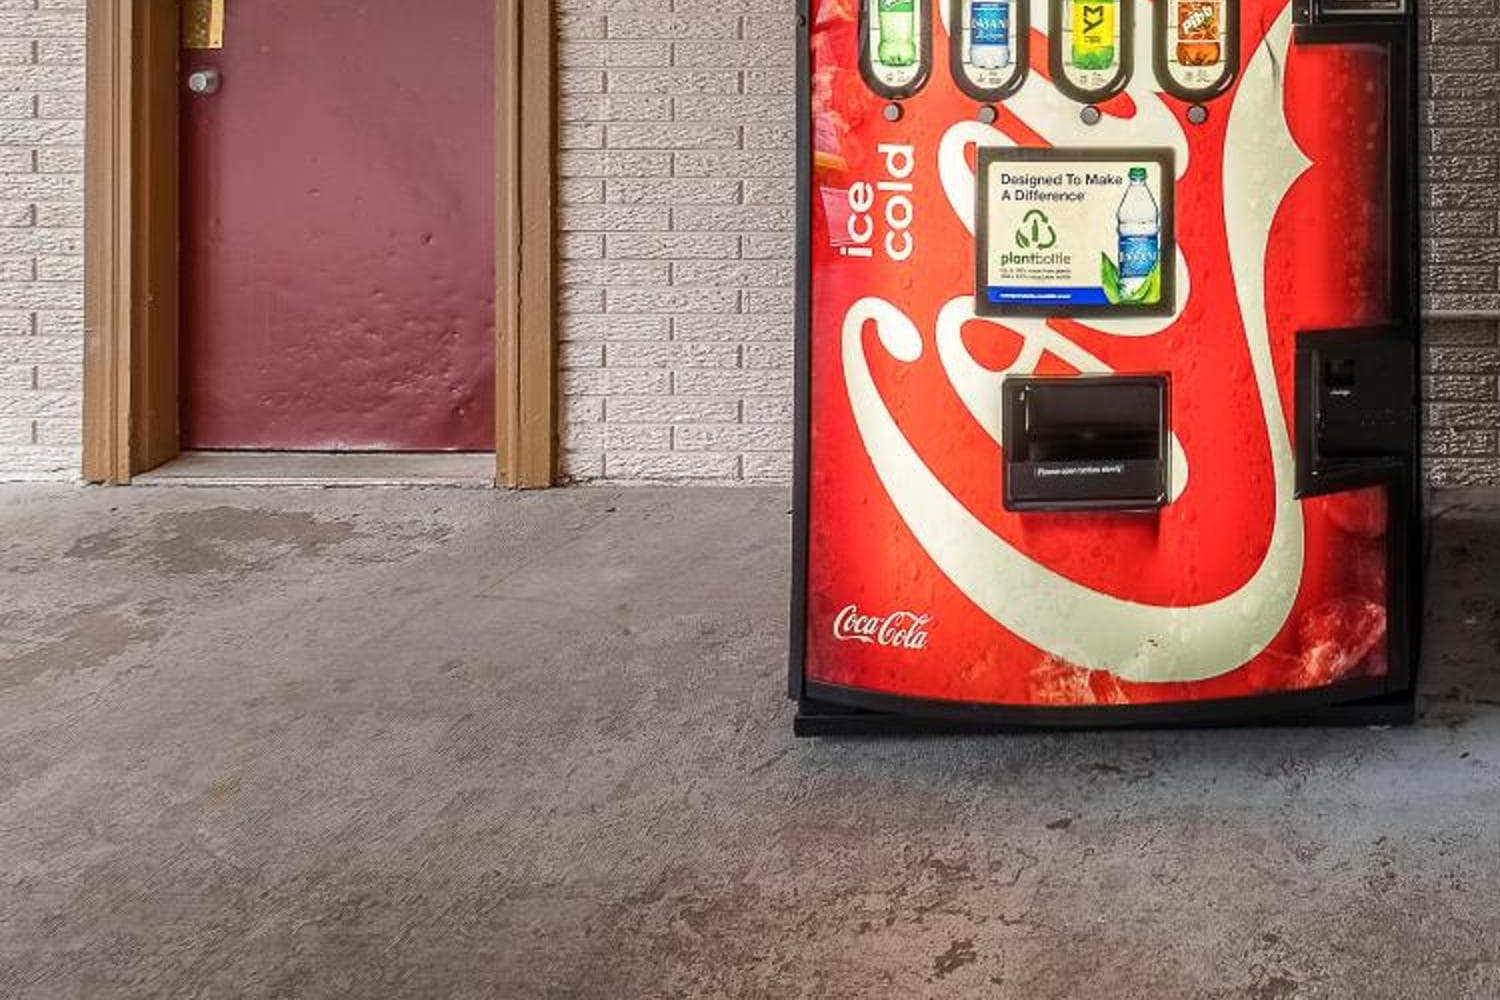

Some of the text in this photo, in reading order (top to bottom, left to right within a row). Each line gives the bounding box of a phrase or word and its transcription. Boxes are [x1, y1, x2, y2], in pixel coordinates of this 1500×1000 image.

[1001, 173, 1123, 187] Designed To Make
[876, 142, 915, 261] cold
[1001, 190, 1085, 201] A Difference
[839, 180, 874, 257] ice
[1001, 251, 1071, 267] plantbottle
[833, 604, 934, 649] Coca-Cola
